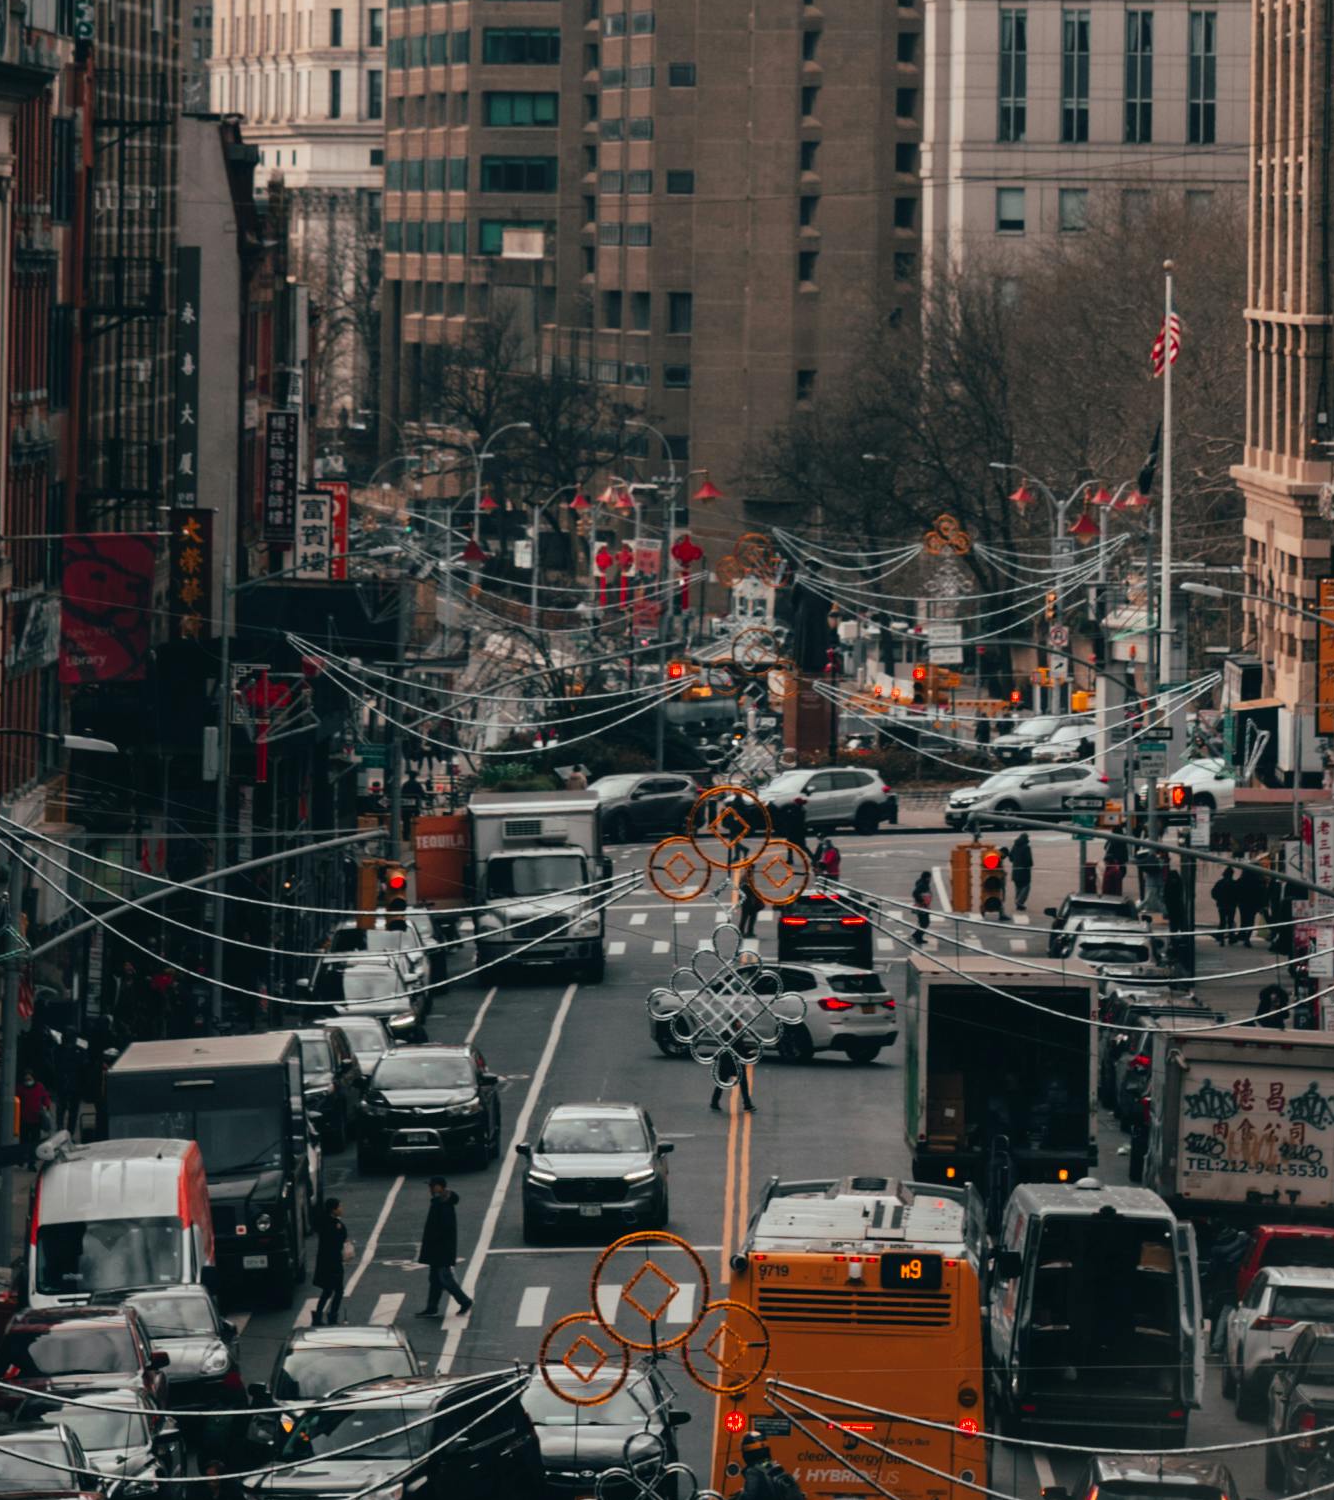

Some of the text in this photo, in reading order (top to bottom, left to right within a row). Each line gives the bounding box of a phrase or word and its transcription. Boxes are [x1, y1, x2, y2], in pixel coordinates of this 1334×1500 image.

[417, 833, 466, 850] TEQUILA
[1186, 1157, 1329, 1179] TEL:212-91-5530
[758, 1265, 789, 1278] 9719
